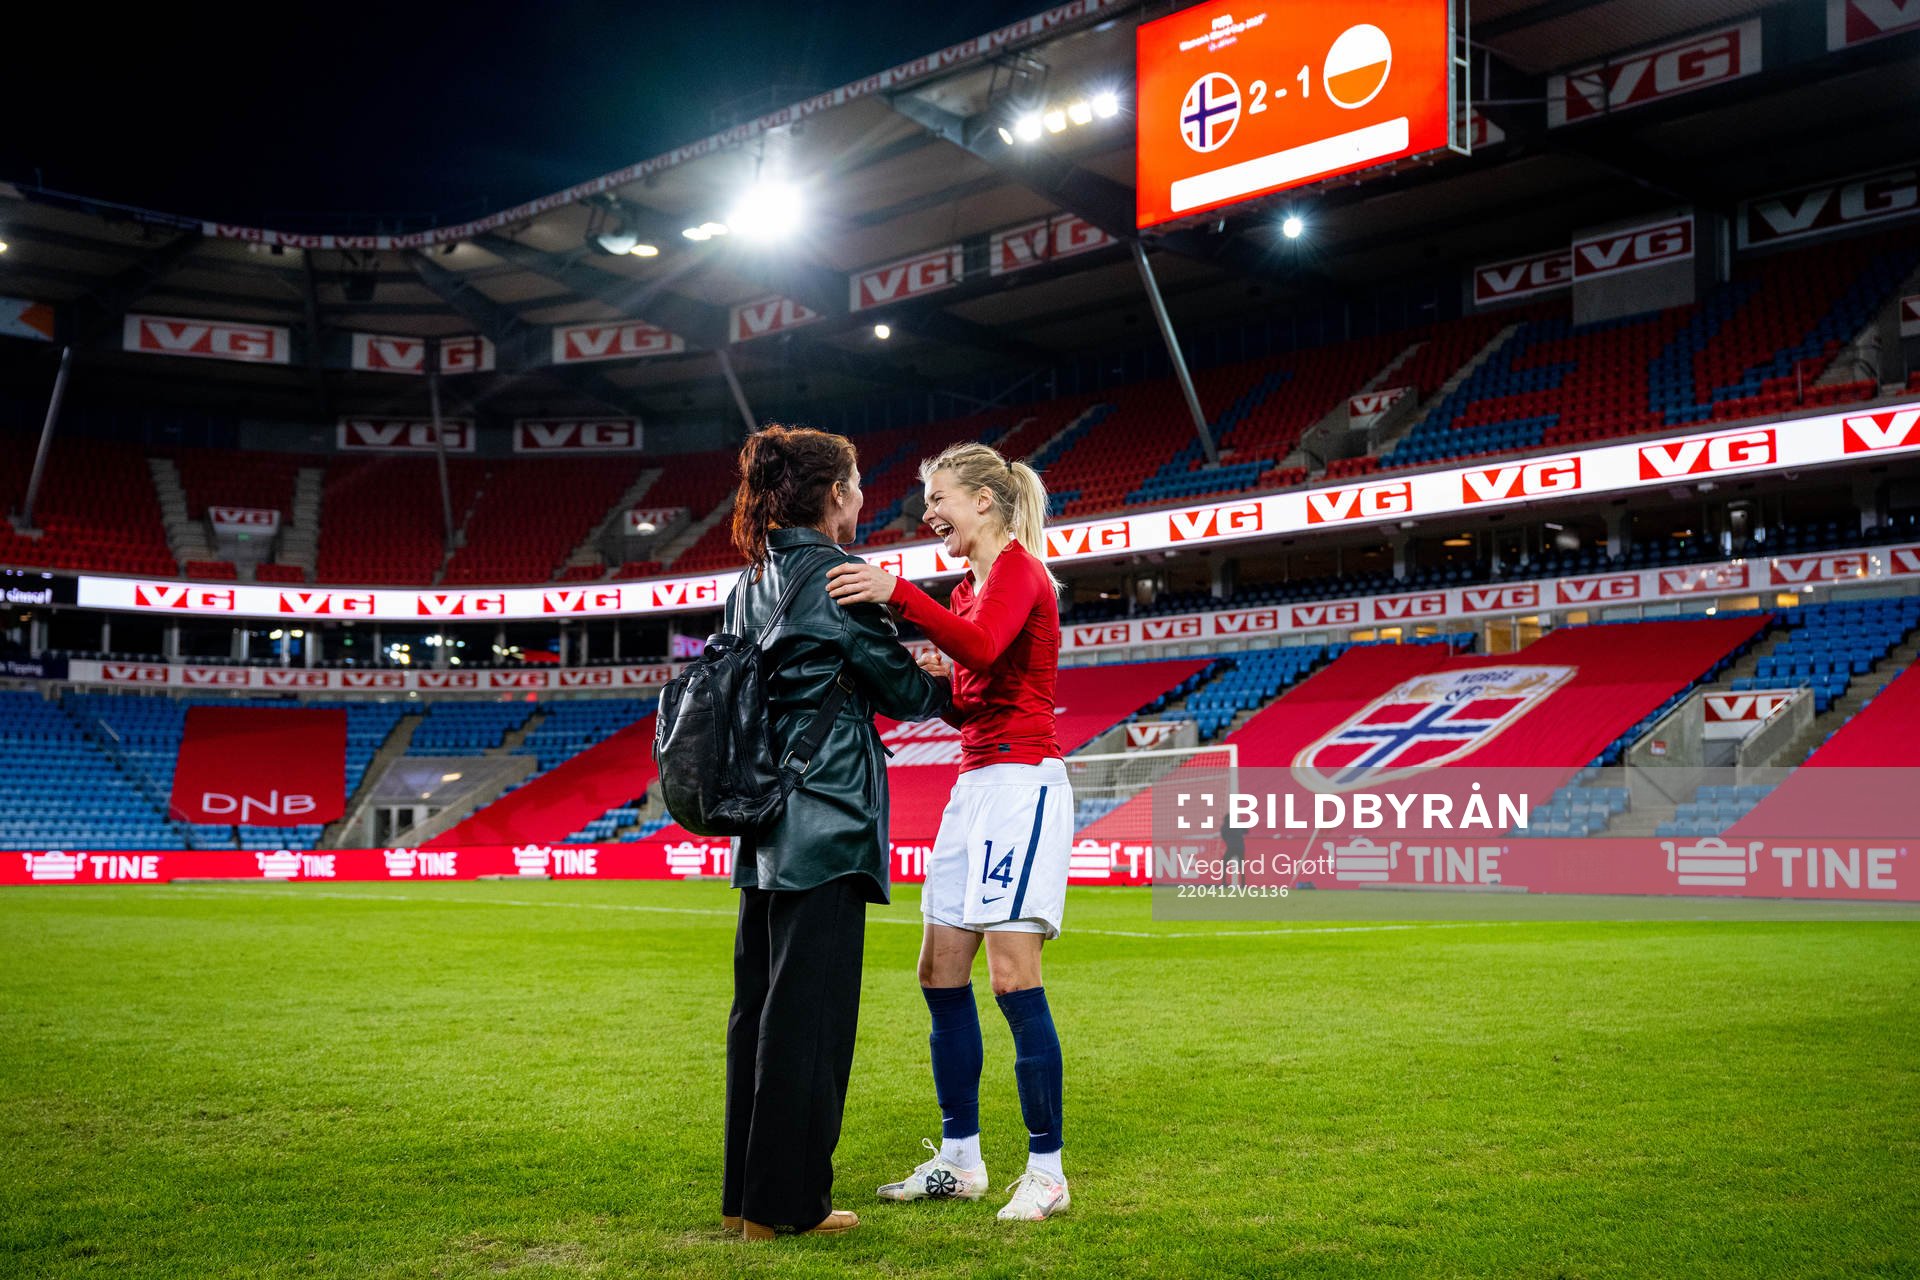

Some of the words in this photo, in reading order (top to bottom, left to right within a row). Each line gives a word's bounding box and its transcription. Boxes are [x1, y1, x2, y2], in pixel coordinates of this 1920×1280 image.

[1570, 38, 1731, 109] VG
[1249, 79, 1267, 114] 2
[1297, 65, 1310, 98] 1
[1753, 171, 1918, 234] VG
[1579, 227, 1683, 268] VG
[863, 254, 946, 301] VG
[1483, 256, 1571, 294] VG
[144, 322, 271, 358] VG
[571, 327, 671, 356] VG
[350, 421, 465, 446] VG
[527, 421, 629, 447] VG
[1641, 432, 1769, 477] VG
[1465, 459, 1577, 502] VG
[1309, 484, 1408, 522] VG
[1171, 503, 1258, 541] VG
[1048, 523, 1126, 556] VG
[1662, 567, 1744, 593] VG
[1774, 557, 1863, 585] VG
[138, 586, 232, 609] VG
[545, 590, 618, 611] VG
[654, 581, 715, 606] VG
[1465, 586, 1536, 611] VG
[1561, 577, 1636, 602] VG
[281, 593, 372, 614] VG
[418, 595, 503, 614] VG
[1295, 604, 1356, 626] VG
[1377, 596, 1443, 618] VG
[1145, 620, 1198, 640] VG
[1217, 612, 1275, 632] VG
[1077, 626, 1127, 646] VG
[105, 665, 166, 682] VG
[185, 669, 247, 685] VG
[266, 671, 326, 686] VG
[343, 672, 401, 687] VG
[420, 674, 475, 687] VG
[492, 672, 547, 687] VG
[561, 670, 610, 685] VG
[626, 667, 670, 684] VG
[202, 790, 316, 822] DNB
[91, 855, 160, 879] TINE
[303, 854, 336, 878] TINE
[418, 851, 457, 876] TINE
[552, 848, 598, 875] TINE
[710, 847, 731, 874] TI
[982, 840, 1015, 888] 14
[1122, 846, 1199, 879] TINE
[1407, 846, 1502, 884] TINE
[1772, 848, 1897, 890] TINE
